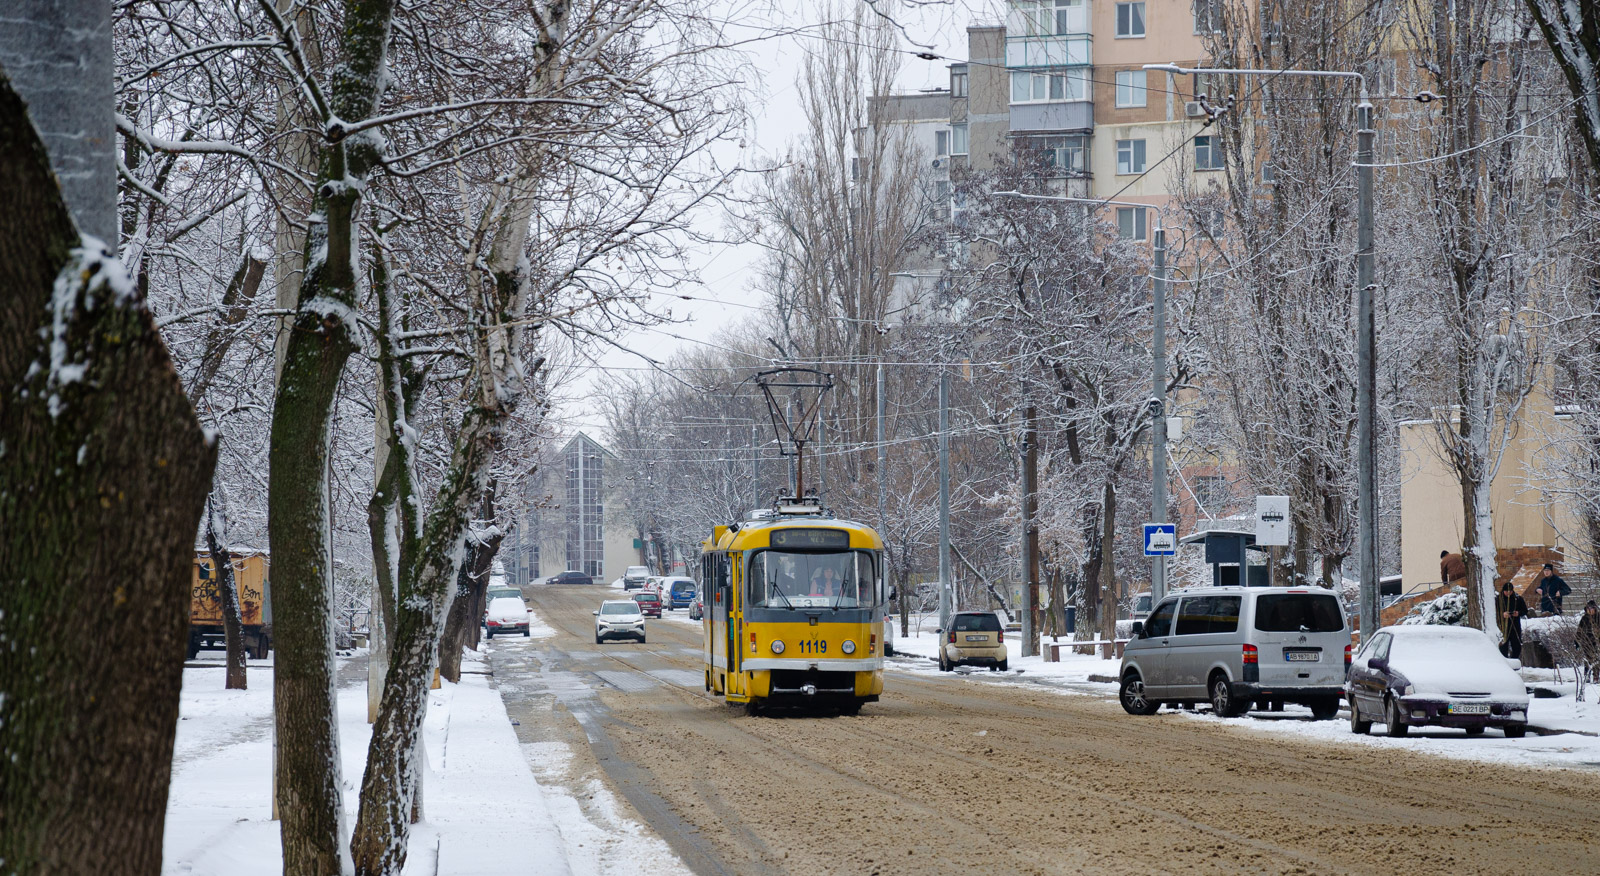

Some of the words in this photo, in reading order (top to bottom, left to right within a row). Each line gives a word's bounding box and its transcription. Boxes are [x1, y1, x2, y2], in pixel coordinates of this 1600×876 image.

[777, 531, 786, 544] 3
[799, 640, 827, 653] 1119
[1452, 705, 1462, 713] BE
[1463, 705, 1478, 713] 0221
